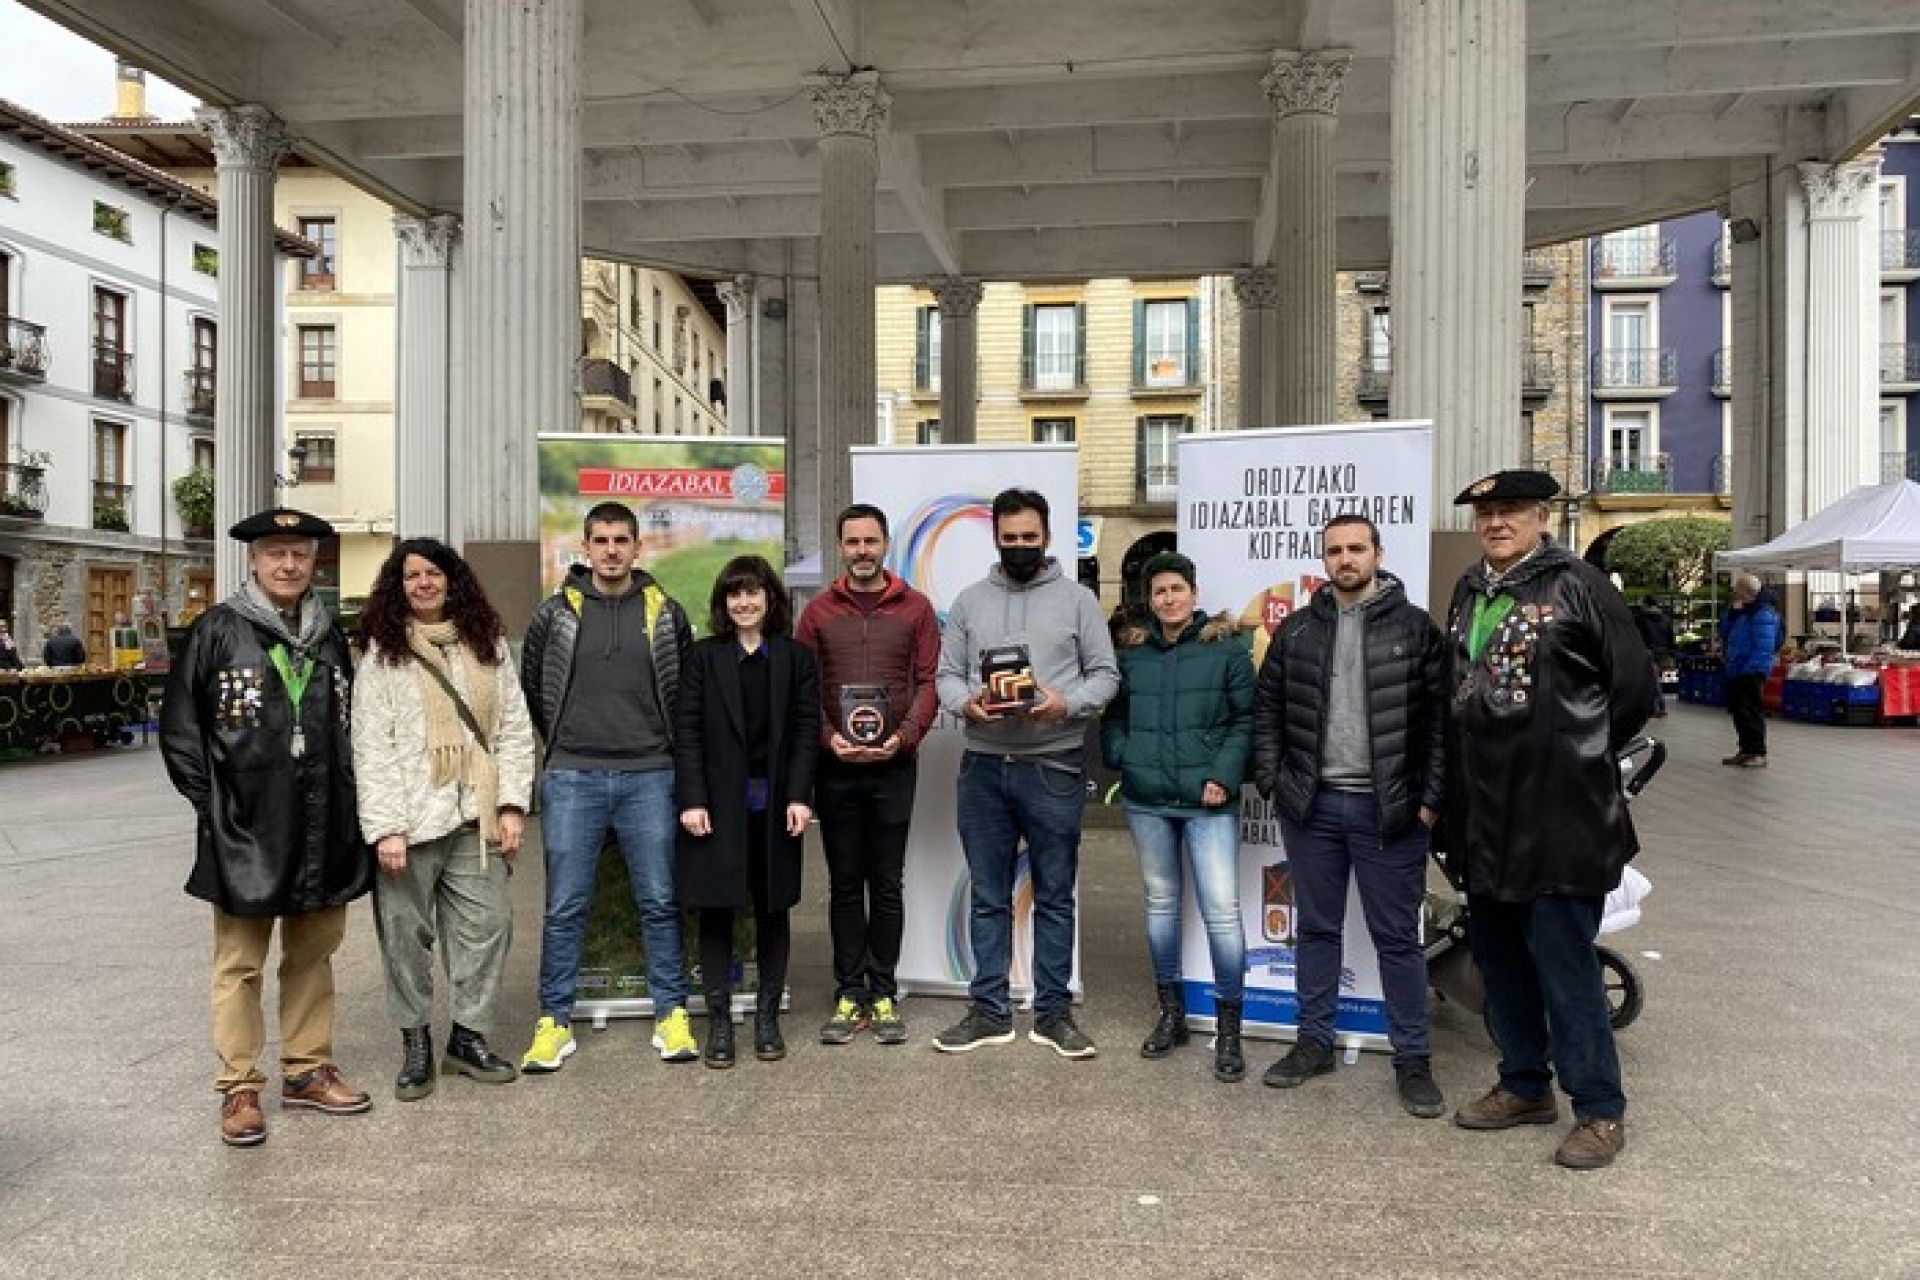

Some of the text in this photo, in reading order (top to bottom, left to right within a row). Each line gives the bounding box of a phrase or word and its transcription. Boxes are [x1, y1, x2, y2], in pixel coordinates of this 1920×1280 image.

[608, 472, 730, 494] IDIAZABAL
[1244, 463, 1356, 497] ORDIZIAKO
[1189, 495, 1414, 530] IDIAZABAL GAZTAREN
[1247, 530, 1325, 560] KOFRAD
